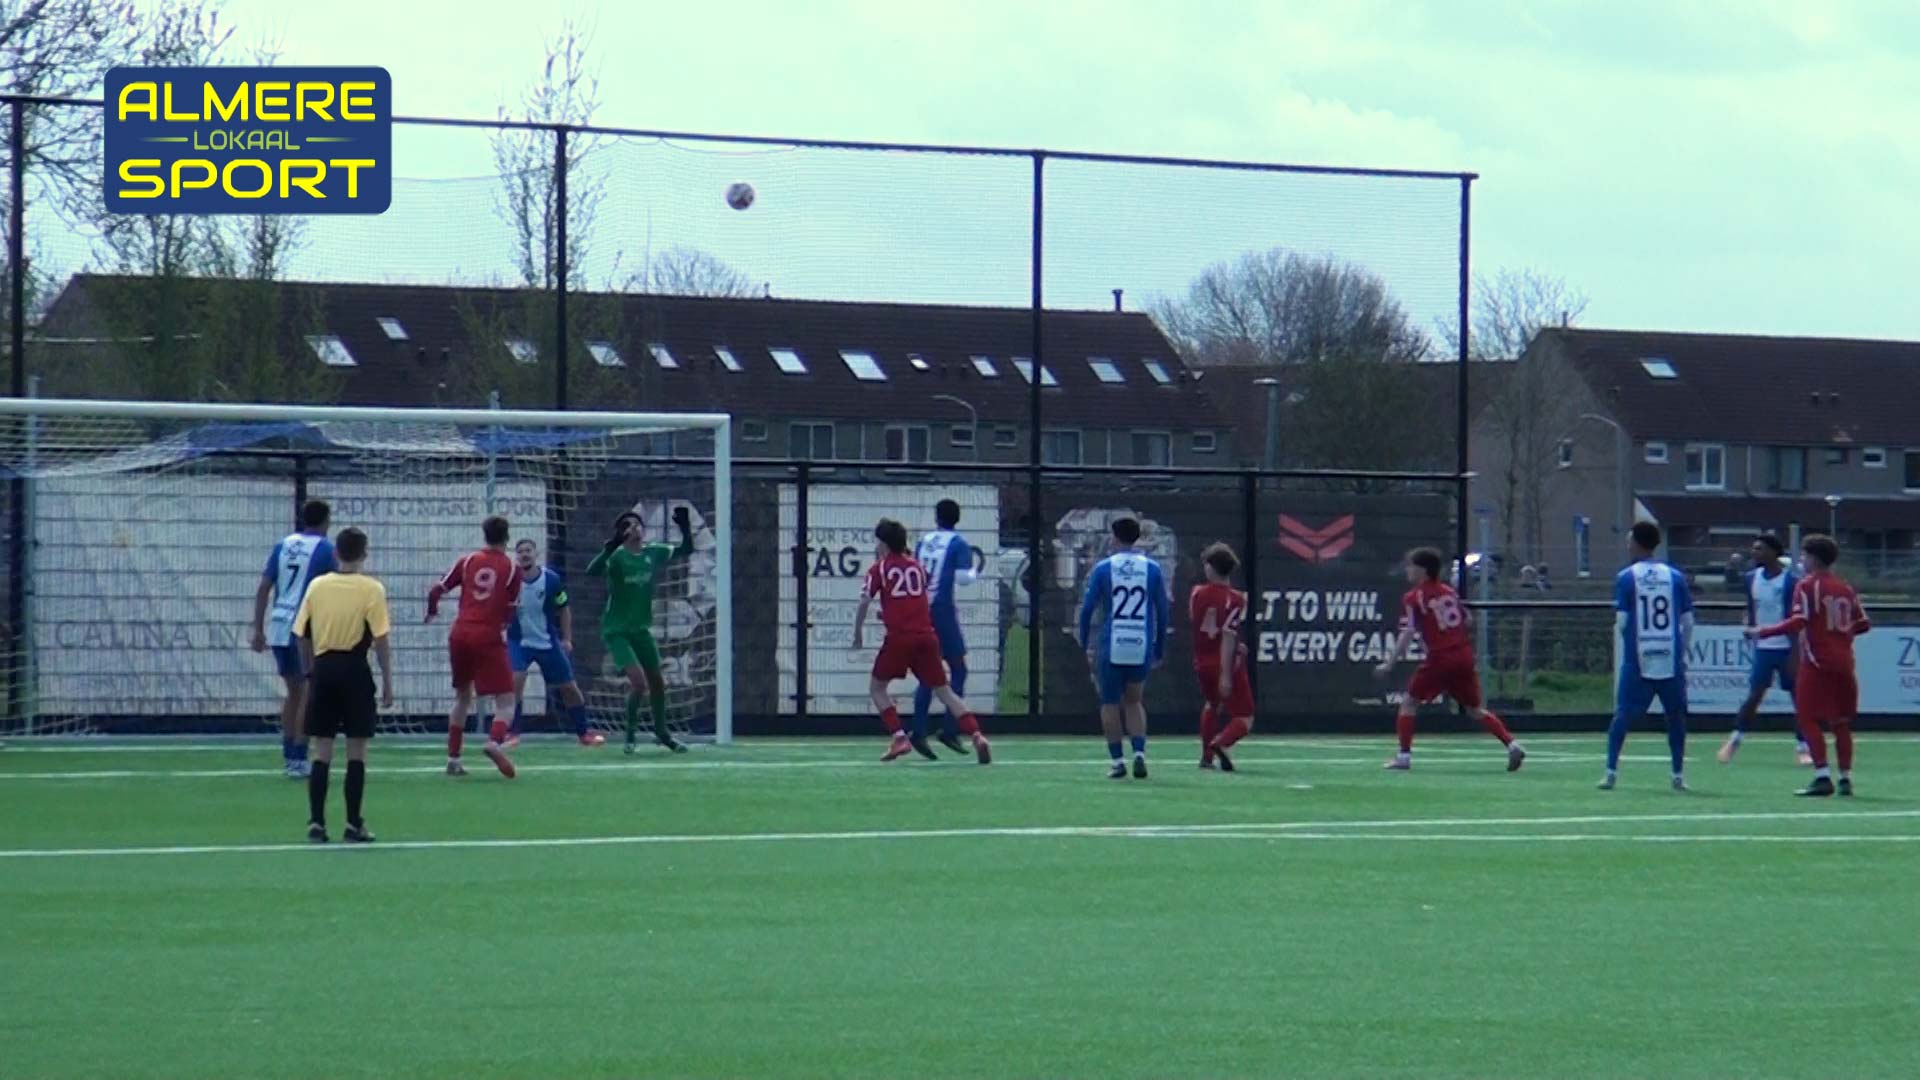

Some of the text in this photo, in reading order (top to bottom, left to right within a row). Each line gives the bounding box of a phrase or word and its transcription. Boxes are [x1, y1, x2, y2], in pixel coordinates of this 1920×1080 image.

[287, 563, 300, 593] 7
[472, 567, 497, 600] 9
[887, 566, 923, 597] 20
[1112, 585, 1146, 620] 22
[1285, 591, 1319, 621] TO
[1325, 591, 1383, 621] WIN.
[1639, 595, 1670, 631] 18
[1824, 596, 1851, 633] 10
[1200, 607, 1220, 640] 4
[1256, 631, 1345, 662] EVERY
